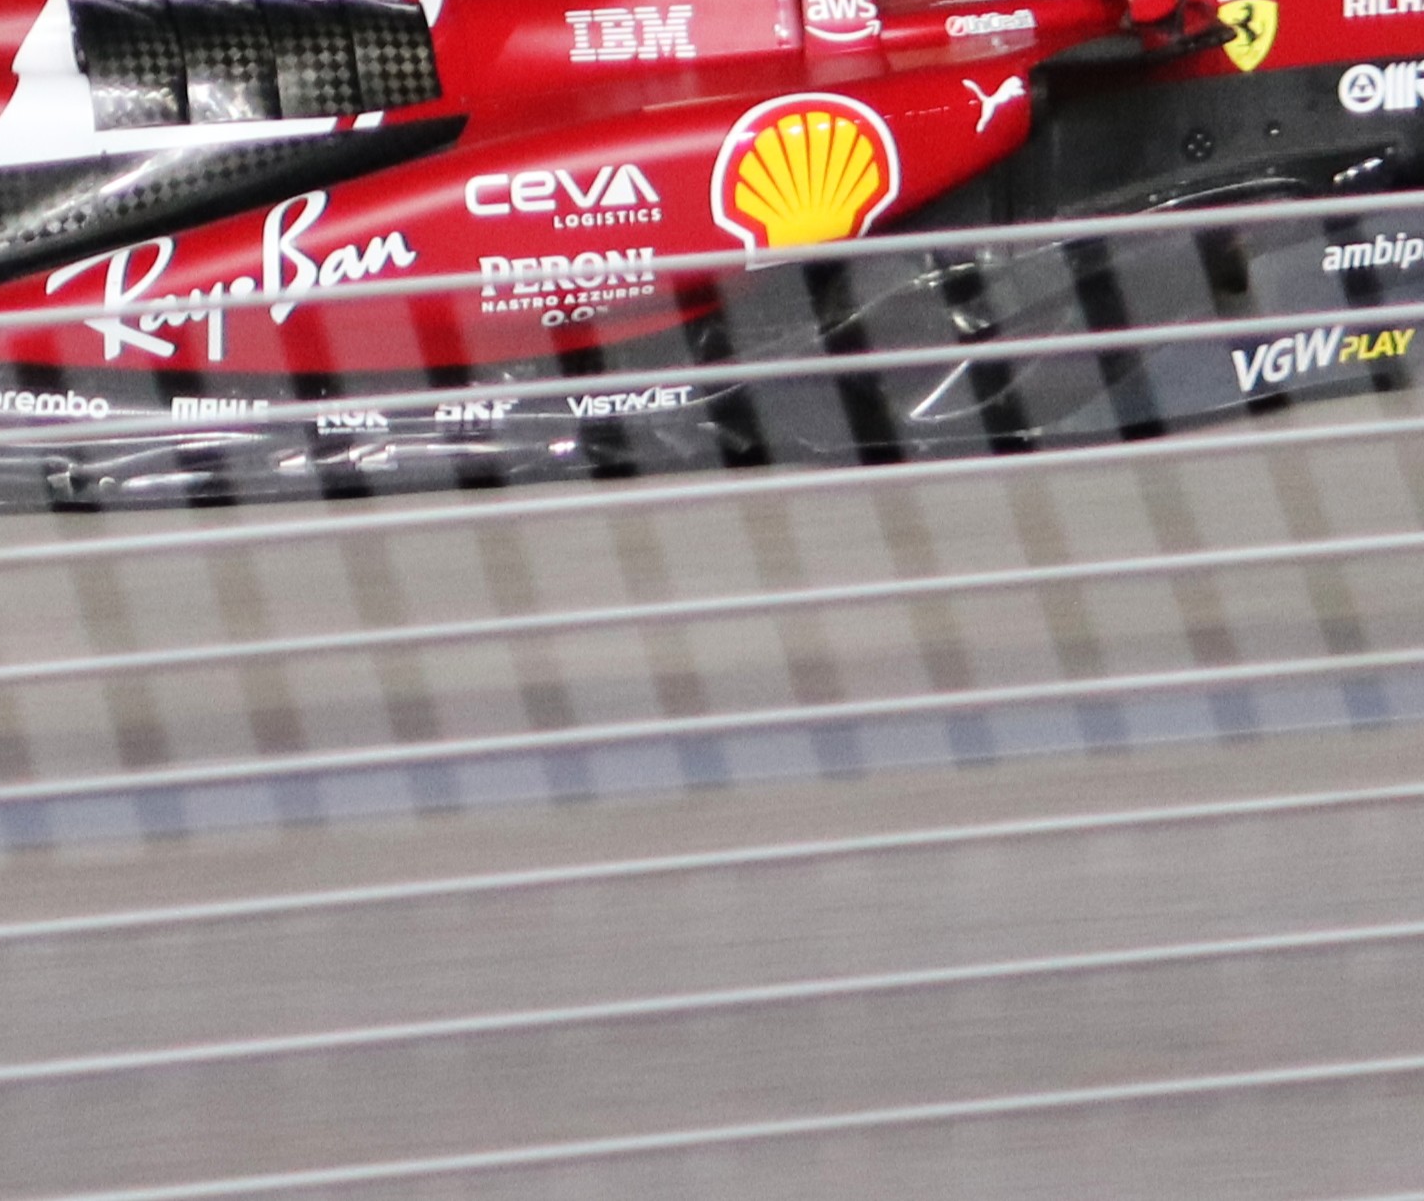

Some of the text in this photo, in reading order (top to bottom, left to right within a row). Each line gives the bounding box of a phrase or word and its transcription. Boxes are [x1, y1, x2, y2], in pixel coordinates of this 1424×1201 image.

[565, 4, 697, 63] IBM
[553, 207, 663, 229] LOGISTICS
[478, 247, 655, 297] PERONI
[481, 284, 655, 313] NASTRO AZZURRO
[1231, 324, 1416, 392] VGW PLAY
